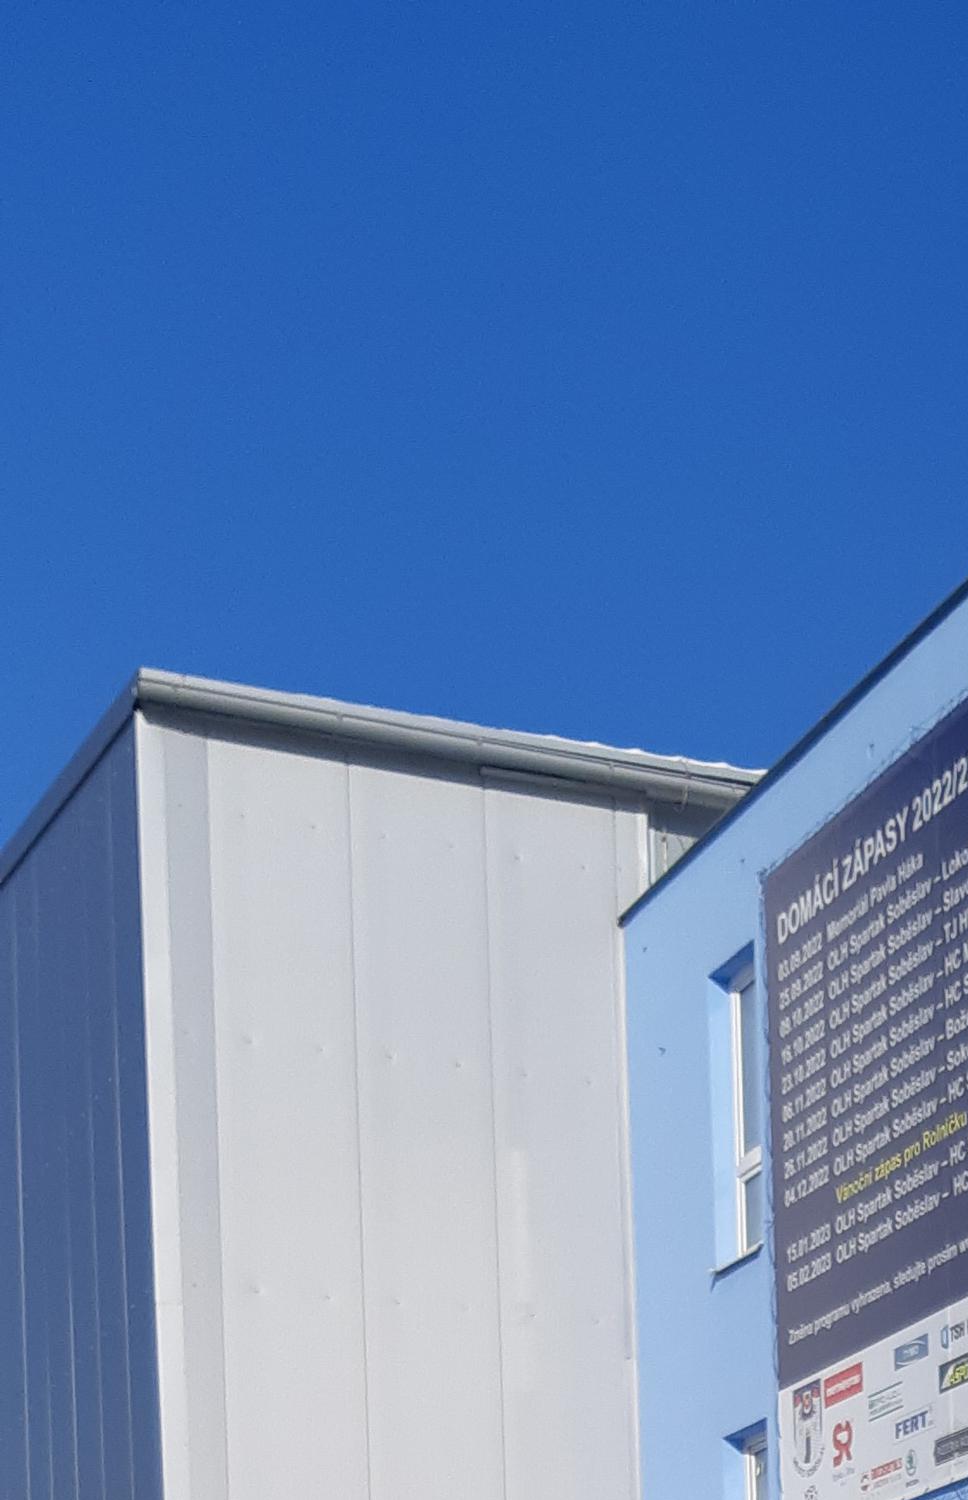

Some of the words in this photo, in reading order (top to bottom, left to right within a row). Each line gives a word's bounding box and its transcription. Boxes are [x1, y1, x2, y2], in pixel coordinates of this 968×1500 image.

[777, 859, 839, 945] DOMÁCÍ
[841, 806, 909, 892] ZÁPASY
[869, 875, 897, 908] Pavla
[827, 941, 849, 971] OLH
[849, 913, 886, 955] Spartak
[886, 878, 932, 925] Soběslav
[827, 970, 849, 1000] OLH
[850, 943, 886, 984] Spartak
[887, 909, 933, 955] Soběslav
[829, 1000, 850, 1030] OLH
[851, 973, 887, 1015] Spartak
[887, 940, 934, 986] Soběslav
[943, 917, 958, 944] TJ
[829, 1029, 851, 1059] OLH
[851, 1003, 888, 1044] Spartak
[888, 972, 935, 1017] Soběslav
[944, 948, 962, 976] HC
[830, 1059, 852, 1089] OLH
[852, 1034, 889, 1074] Spartak
[888, 1004, 935, 1047] Soběslav
[944, 980, 962, 1009] HC
[830, 1089, 852, 1118] OLH
[853, 1065, 889, 1104] Spartak
[889, 1035, 935, 1078] Soběslav
[832, 1119, 853, 1147] OLH
[853, 1095, 890, 1134] Spartak
[890, 1067, 937, 1109] Soběslav
[833, 1148, 855, 1176] OLH
[855, 1125, 892, 1164] Spartak
[892, 1098, 938, 1139] Soběslav
[947, 1076, 965, 1103] HC
[874, 1152, 902, 1182] zápas
[903, 1141, 921, 1168] pro
[922, 1111, 968, 1151] Rolničku
[834, 1207, 856, 1235] OLH
[856, 1186, 893, 1223] Spartak
[893, 1160, 940, 1200] Soběslav
[949, 1140, 966, 1167] HC
[835, 1237, 857, 1264] OLH
[857, 1217, 894, 1253] Spartak
[894, 1192, 940, 1230] Soběslav
[894, 1409, 929, 1440] FERT
